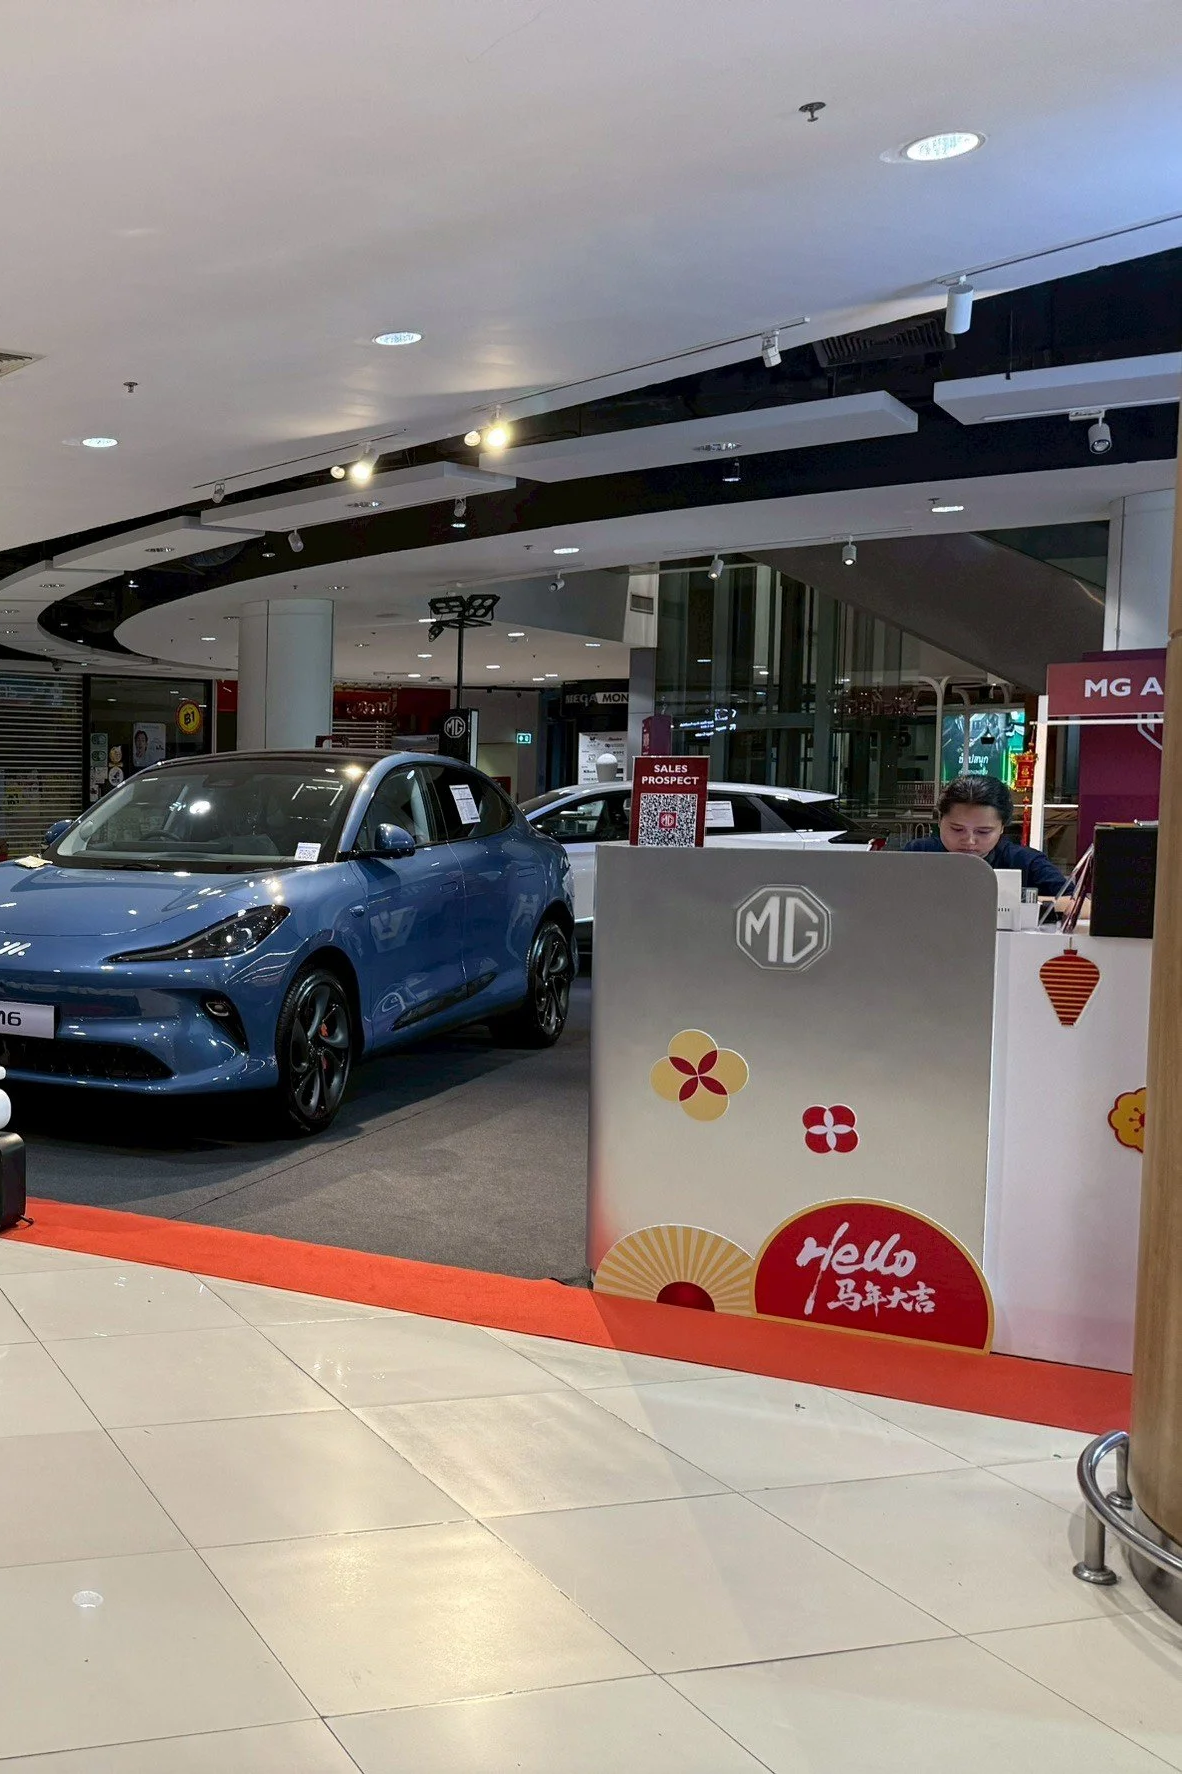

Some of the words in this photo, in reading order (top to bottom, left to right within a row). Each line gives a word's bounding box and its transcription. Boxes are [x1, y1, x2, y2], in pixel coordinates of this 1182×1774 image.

[1084, 677, 1131, 697] MG
[445, 717, 465, 737] MG
[654, 764, 688, 773] SALES
[641, 776, 699, 785] PROSPECT
[742, 893, 822, 964] MG
[796, 1221, 916, 1315] Hello
[827, 1278, 936, 1318] 马年大吉
